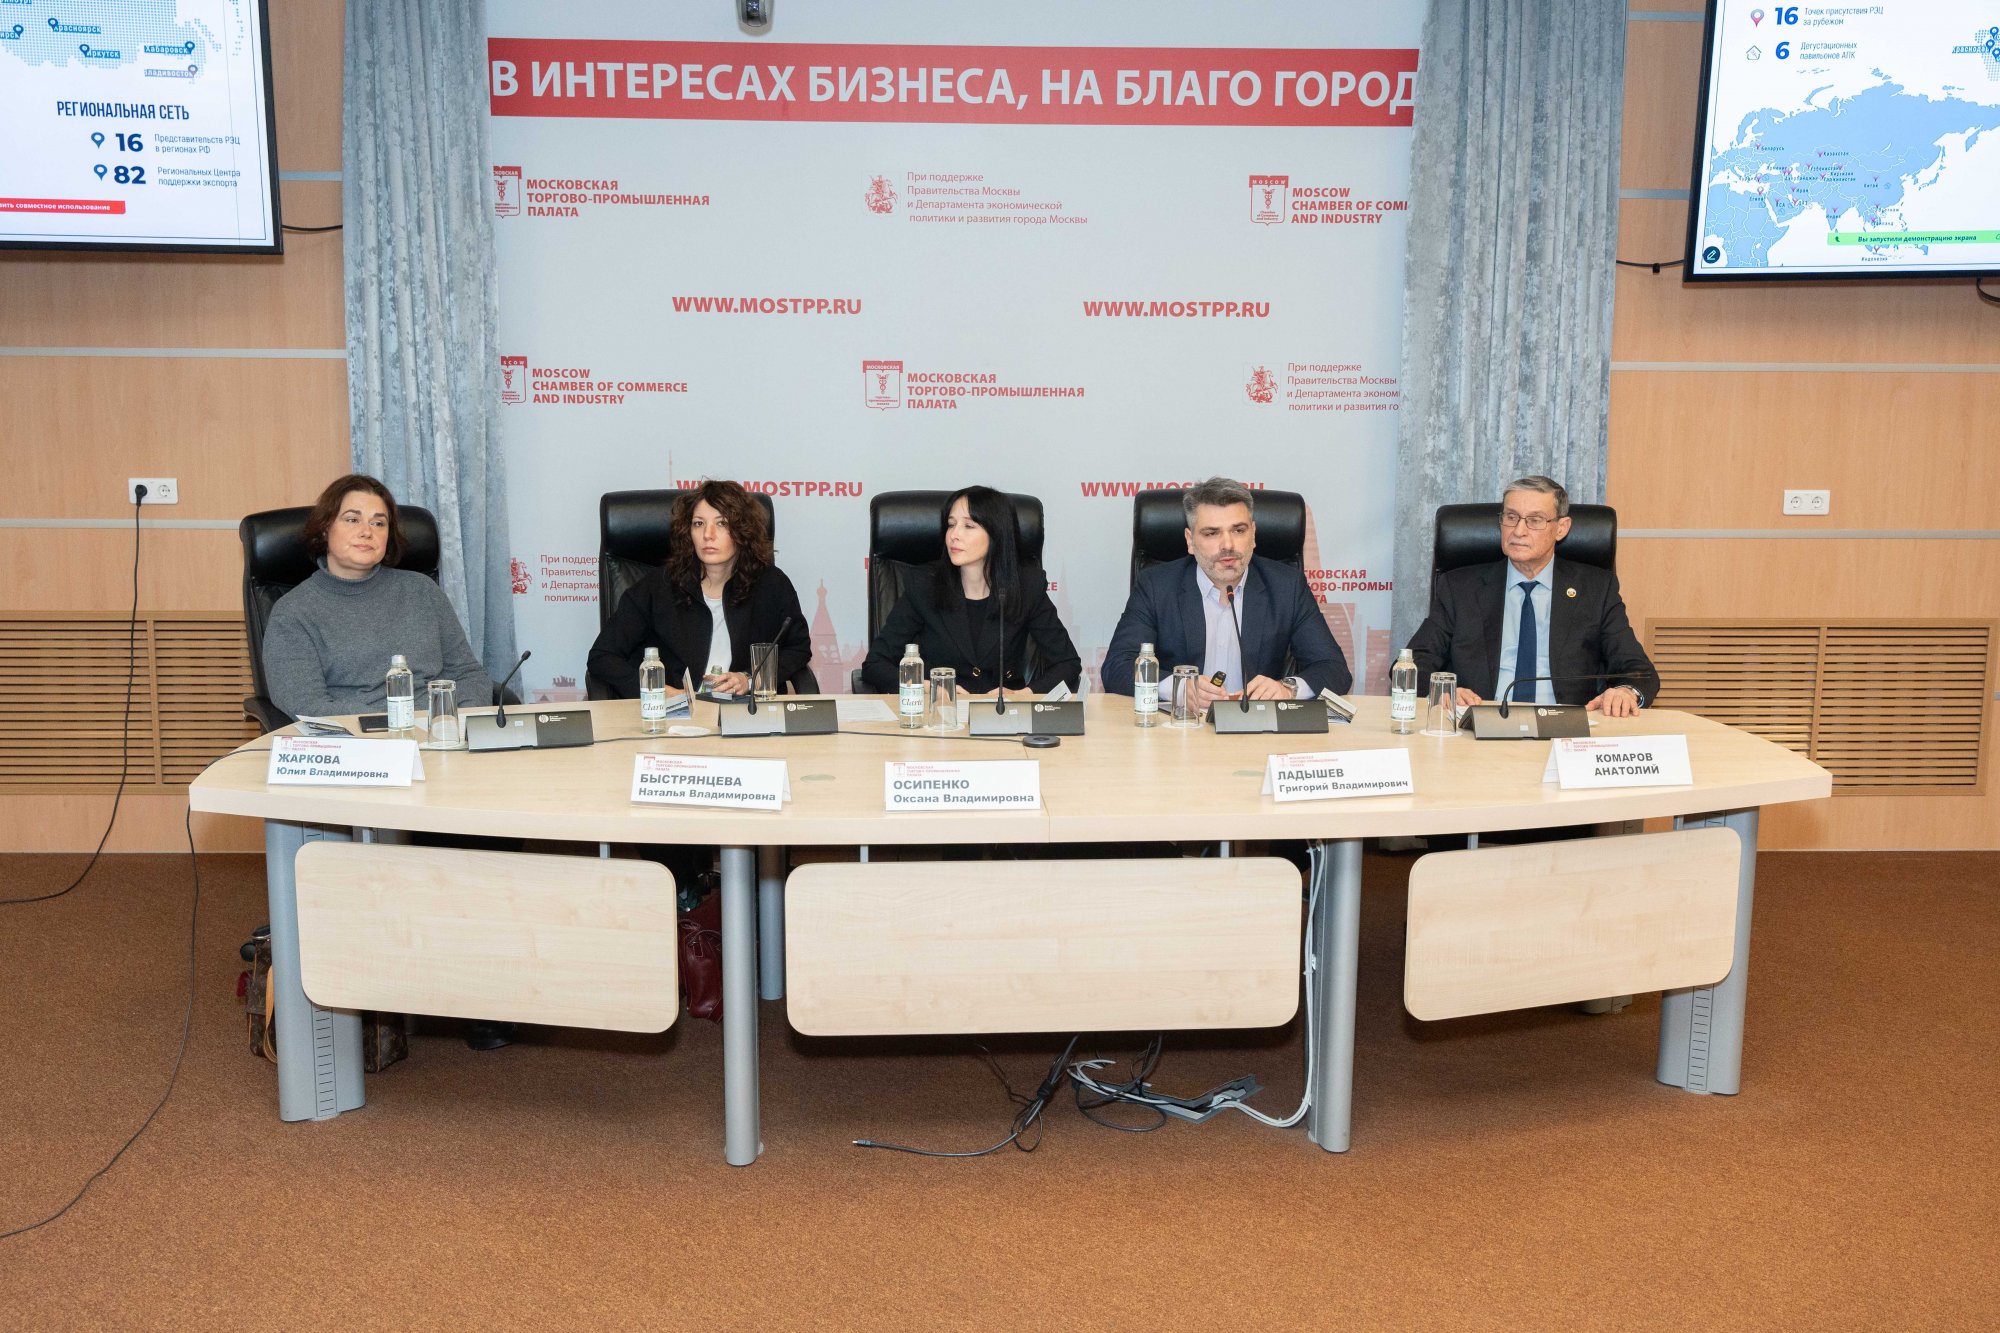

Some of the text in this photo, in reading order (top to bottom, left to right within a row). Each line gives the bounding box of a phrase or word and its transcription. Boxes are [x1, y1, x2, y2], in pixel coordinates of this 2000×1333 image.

[1774, 7, 1798, 25] 16
[1826, 8, 1868, 16] присутствия
[1869, 6, 1884, 15] РЭЦ
[1813, 18, 1844, 27] рубежом
[1776, 42, 1790, 60] 6
[1800, 42, 1858, 51] Дегустационных
[1800, 51, 1856, 60] павильонов АПК
[492, 60, 519, 97] В
[531, 61, 796, 102] ИНТЕРЕСАХ
[809, 66, 1028, 110] БИЗНЕСА,
[1041, 69, 1103, 106] НА
[1116, 70, 1262, 107] БЛАГО
[57, 100, 190, 120] РЕГИОНАЛЬНАЯ СЕТЬ
[115, 132, 144, 152] 16
[154, 134, 240, 146] Представительств РЭЦ
[162, 146, 197, 154] регионах
[199, 146, 210, 154] РФ
[114, 165, 146, 184] 82
[158, 166, 240, 178] Региональных Центра
[907, 172, 984, 183] При поддержке
[158, 178, 238, 188] поддержки экспорта
[526, 179, 618, 190] МОСКОВСКАЯ
[907, 186, 1020, 196] Правительства Москвы
[1292, 188, 1350, 198] MOSCOW
[526, 192, 710, 206] ТОРГОВО-ПРОМЫШЛЕННАЯ
[916, 200, 984, 210] Департамента
[986, 201, 1062, 210] экономической
[1292, 200, 1352, 210] CHAMBER
[1356, 201, 1373, 210] OF
[528, 206, 579, 217] ПАЛАТА
[966, 216, 1011, 225] развития
[1014, 216, 1047, 226] города
[1049, 216, 1088, 224] Москвы
[1292, 214, 1382, 224] AND INDUSTRY
[1904, 236, 1952, 244] демонстрацию
[672, 296, 862, 314] WWW.MOSTPP.RU
[1083, 301, 1270, 318] WWW.MOSTPP.RU
[1288, 362, 1362, 372] При поддержке
[532, 368, 590, 378] MOSCOW
[907, 372, 996, 384] МОСКОВСКАЯ
[1288, 376, 1397, 386] Правительства Москвы
[532, 381, 688, 392] CHAMBER OF COMMERCE
[907, 386, 1084, 398] ТОРГОВО-ПРОМЫШЛЕННАЯ
[1295, 390, 1362, 399] Департамента
[533, 394, 625, 404] AND INDUSTRY
[907, 399, 958, 409] ПАЛАТА
[1344, 404, 1386, 412] развития
[540, 554, 600, 564] При поддер
[1304, 570, 1367, 579] КОВСКАЯ
[1308, 582, 1392, 592] ОВО-ПРОМЫ
[278, 754, 340, 764] ЖАРКОВА
[1596, 752, 1653, 763] КОМАРОВ
[276, 767, 389, 779] Юлия Владимировна
[1278, 768, 1344, 780] ЛАДЫШЕВ
[1594, 764, 1660, 776] АНАТОЛИЙ
[640, 774, 742, 787] БЫСТРЯНЦЕВА
[894, 780, 970, 790] ОСИПЕНКО
[1280, 780, 1408, 794] Григорий Владимирович
[638, 788, 776, 801] Наталья Владимировна
[894, 794, 1034, 804] Оксана Владимировна
